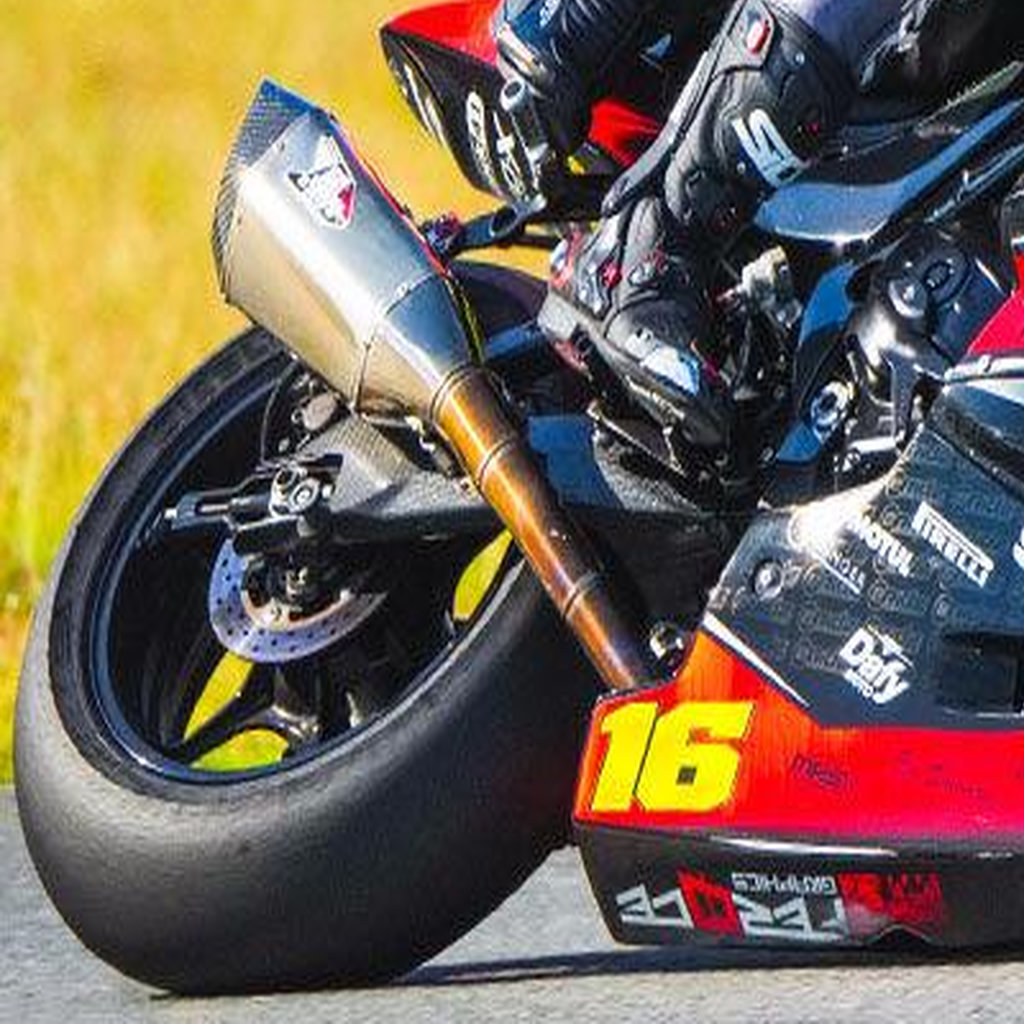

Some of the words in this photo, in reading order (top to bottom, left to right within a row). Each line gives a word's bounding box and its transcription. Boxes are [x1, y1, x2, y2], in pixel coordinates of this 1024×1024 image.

[911, 501, 995, 589] PIRELLI
[838, 627, 912, 705] Dafy
[591, 701, 754, 813] 16
